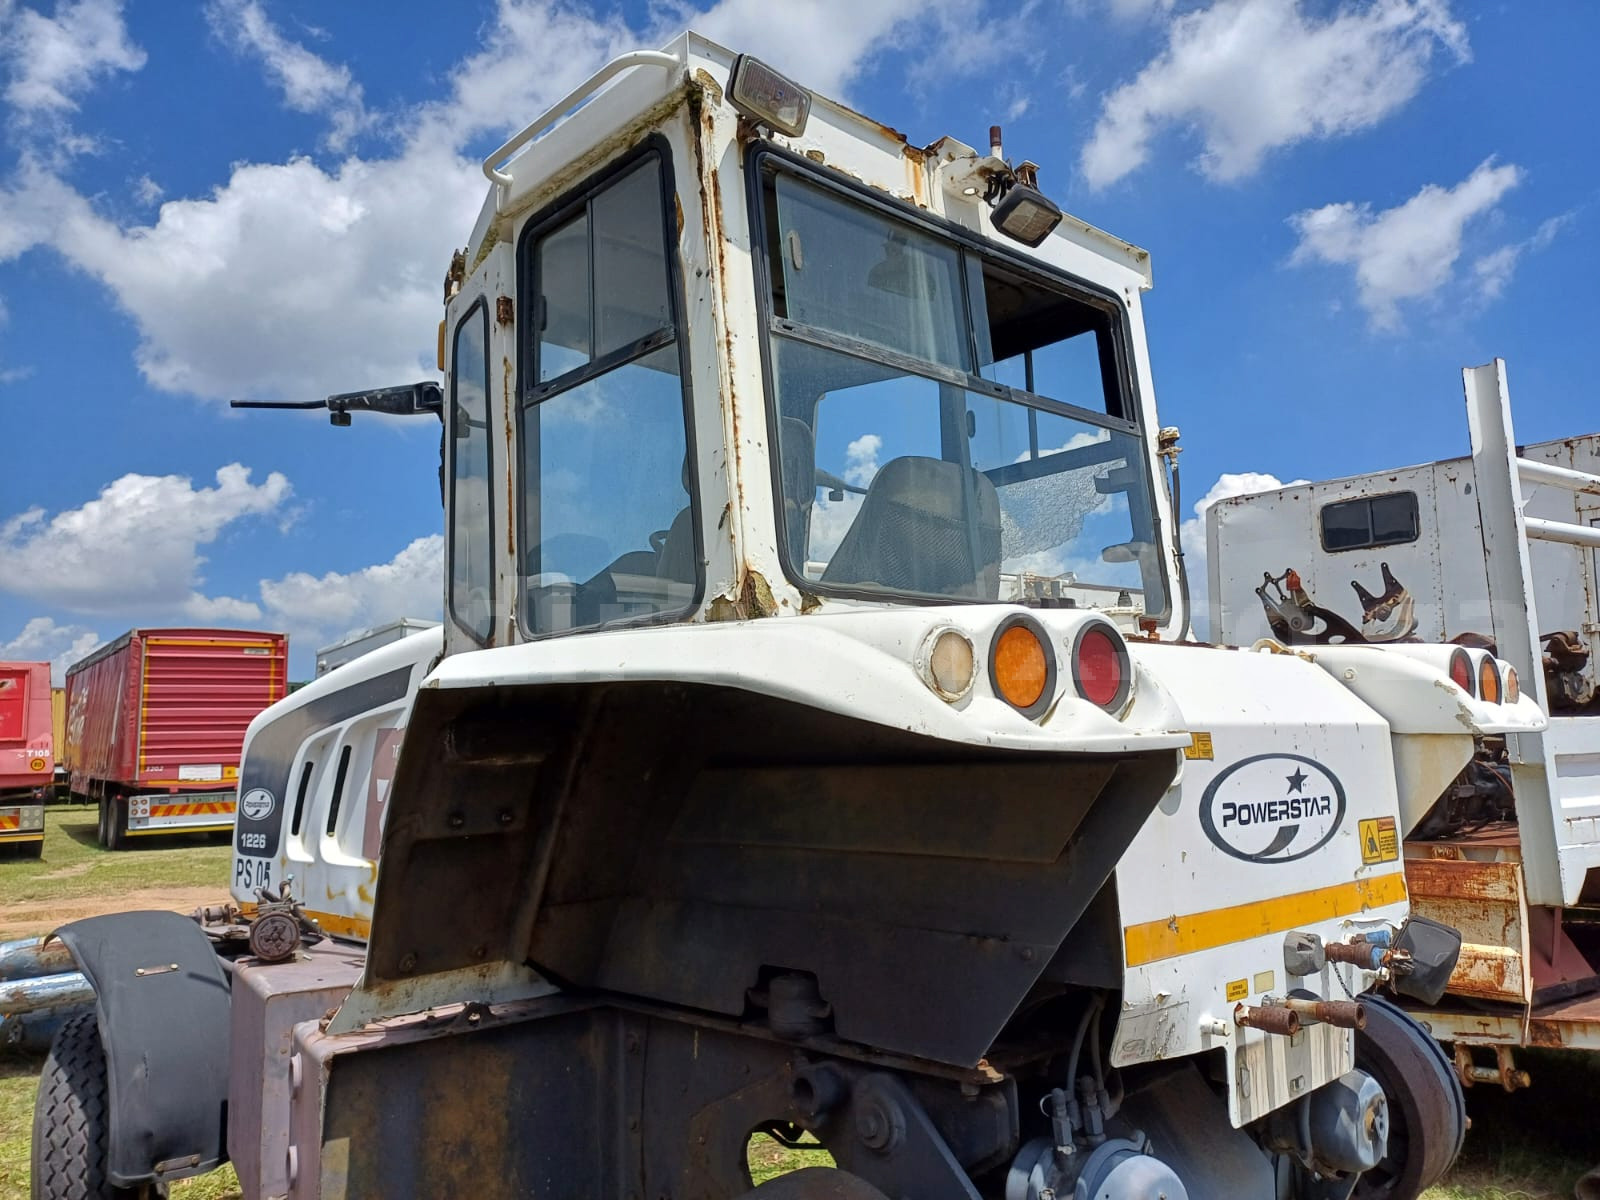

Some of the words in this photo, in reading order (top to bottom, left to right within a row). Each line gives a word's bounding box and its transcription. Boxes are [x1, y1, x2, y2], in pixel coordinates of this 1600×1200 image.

[1222, 796, 1331, 827] POWERSTAR
[241, 833, 266, 849] 1226
[235, 858, 252, 889] PS
